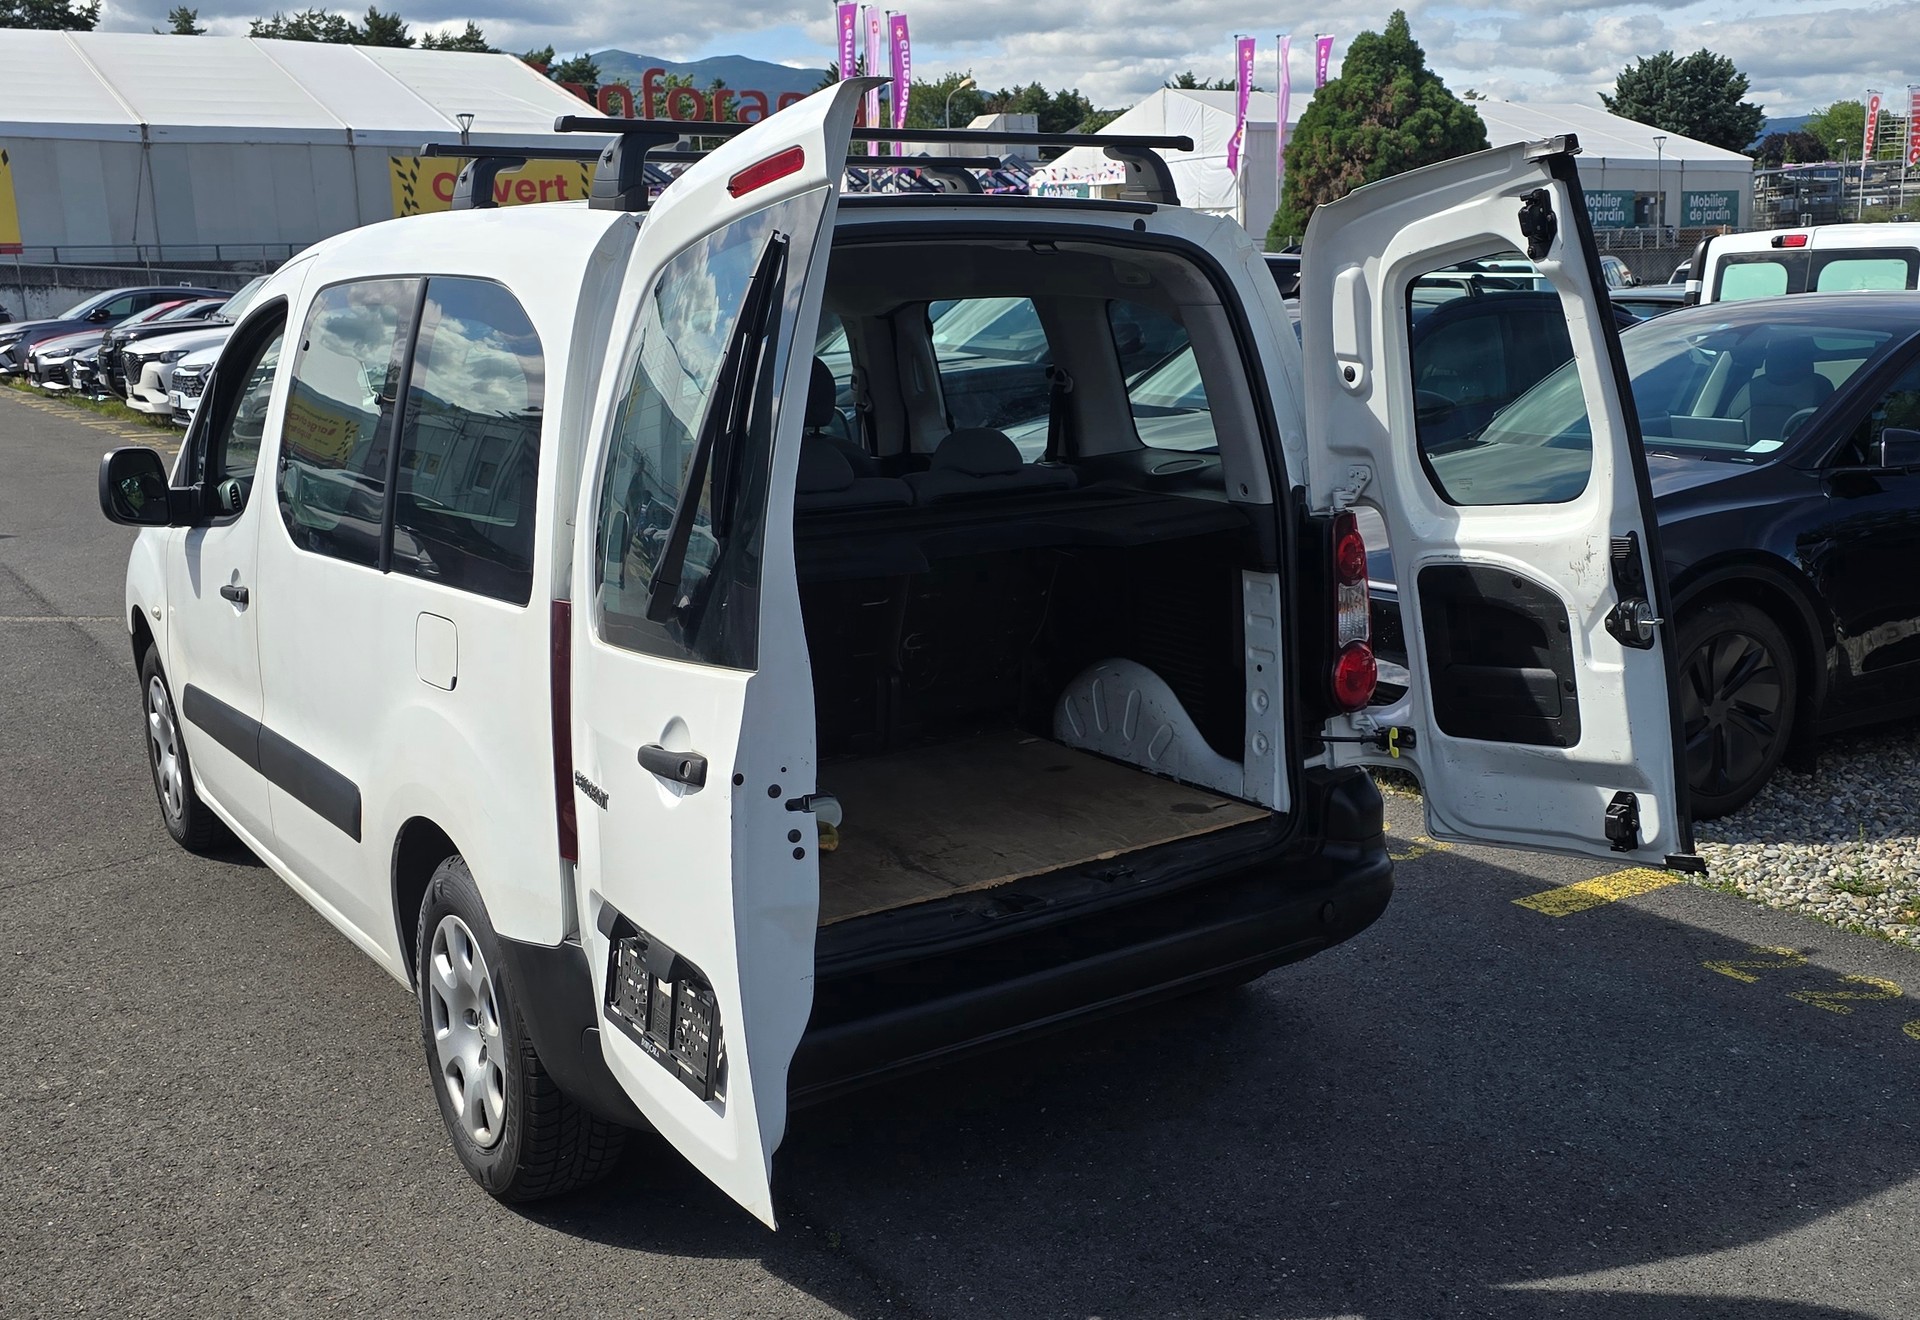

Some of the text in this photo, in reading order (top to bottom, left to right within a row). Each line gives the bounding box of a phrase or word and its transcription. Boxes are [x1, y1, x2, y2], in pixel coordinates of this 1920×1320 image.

[432, 172, 569, 203] Overt
[1690, 193, 1728, 207] Mobilier
[1593, 207, 1625, 226] jardin
[1690, 207, 1730, 224] de jardin
